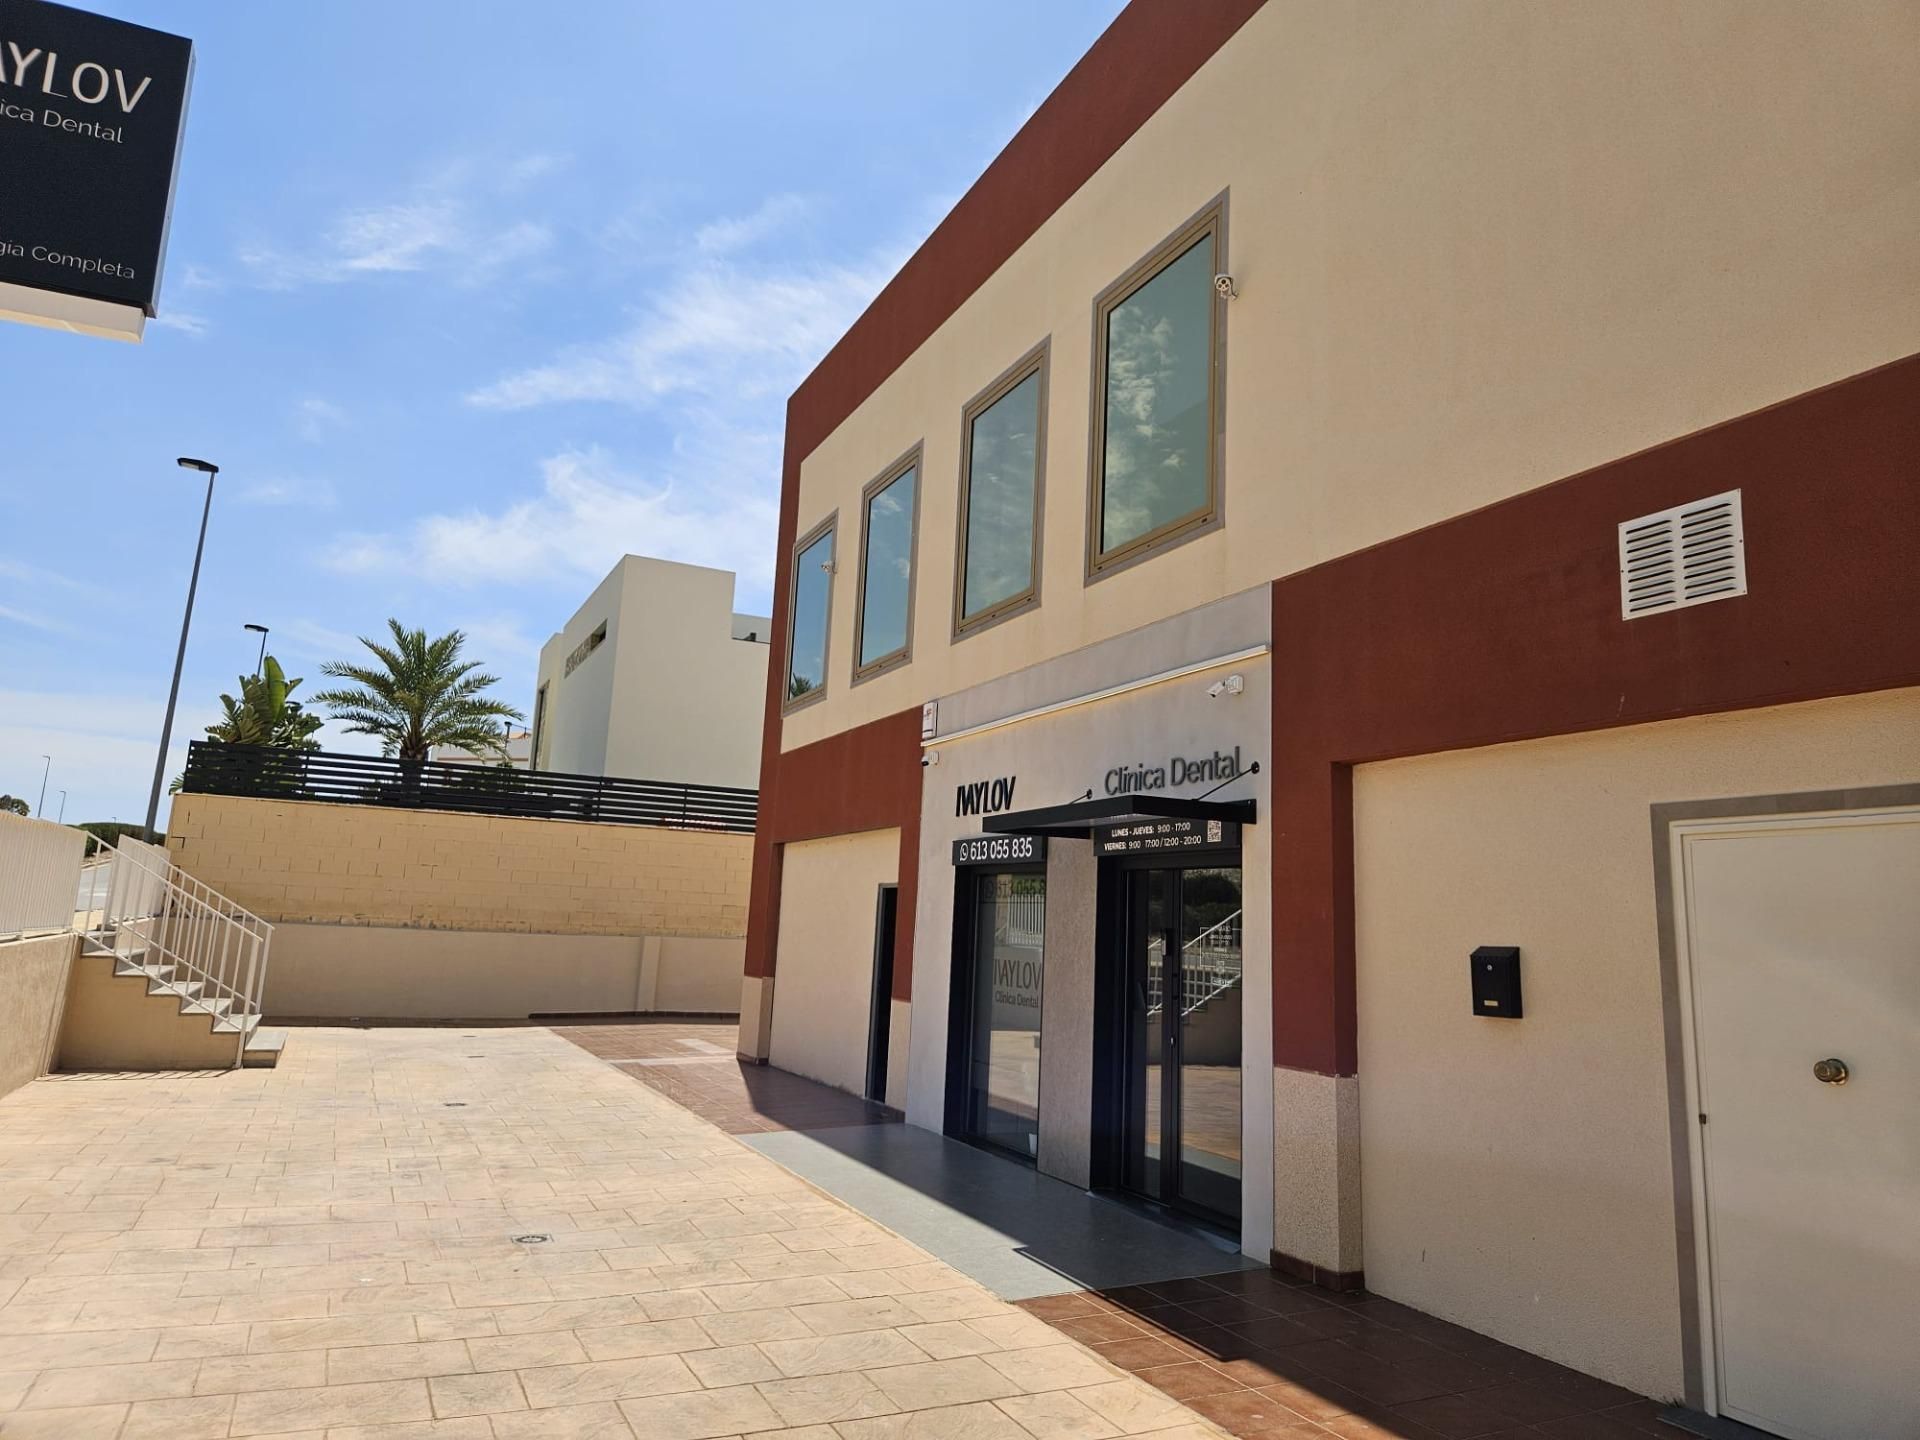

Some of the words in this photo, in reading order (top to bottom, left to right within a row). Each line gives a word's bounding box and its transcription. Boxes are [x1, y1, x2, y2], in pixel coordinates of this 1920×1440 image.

[43, 109, 123, 144] Dental
[32, 246, 135, 279] Completa
[1104, 763, 1165, 795] Clínica
[1170, 746, 1241, 786] Dental
[1111, 828, 1129, 838] LUNES
[1157, 824, 1170, 833] 9:00
[1174, 822, 1191, 832] 17:00
[1128, 840, 1141, 849] 9:00
[1183, 835, 1202, 845] 20:00
[970, 840, 988, 860] 613
[990, 839, 1009, 859] 055
[1012, 837, 1032, 857] 835
